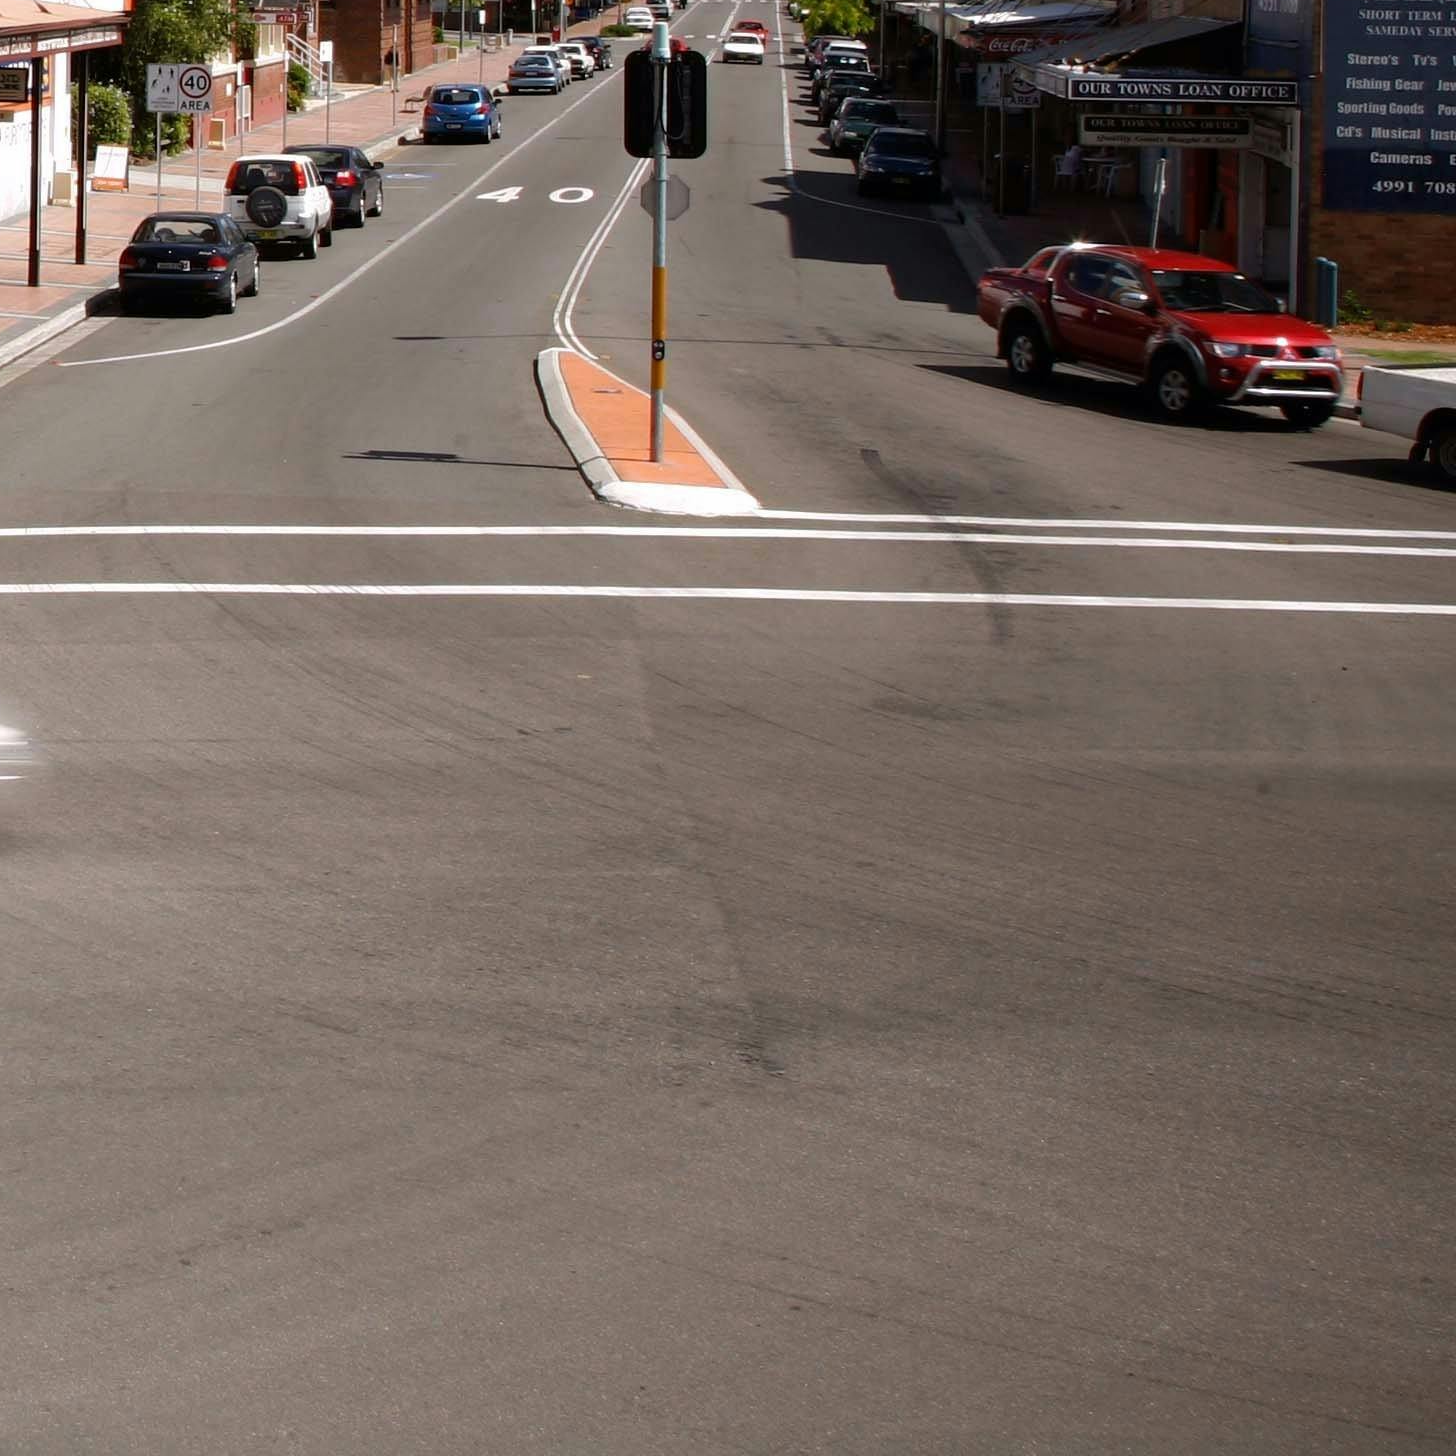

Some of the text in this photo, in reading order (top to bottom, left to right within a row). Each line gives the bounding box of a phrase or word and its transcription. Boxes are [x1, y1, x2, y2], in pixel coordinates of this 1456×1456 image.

[1358, 10, 1401, 20] SHORT
[1408, 11, 1442, 22] TERM
[1365, 25, 1424, 37] SAMEDAY
[1346, 52, 1400, 65] Stereo's
[1412, 54, 1439, 66] Tv's
[184, 75, 207, 90] 40
[1345, 77, 1392, 91] Fishing
[1394, 79, 1425, 91] Gear
[1077, 81, 1289, 99] OUR TOWNS LOAN OFFICE
[180, 100, 210, 111] AREA
[1009, 96, 1039, 105] AREA
[1336, 102, 1388, 115] Sporting
[1388, 103, 1425, 115] Goods
[1335, 125, 1363, 138] Cd's
[1370, 127, 1422, 140] Musical
[1369, 152, 1433, 166] Cameras
[1371, 180, 1415, 194] 4991
[476, 186, 594, 203] 40
